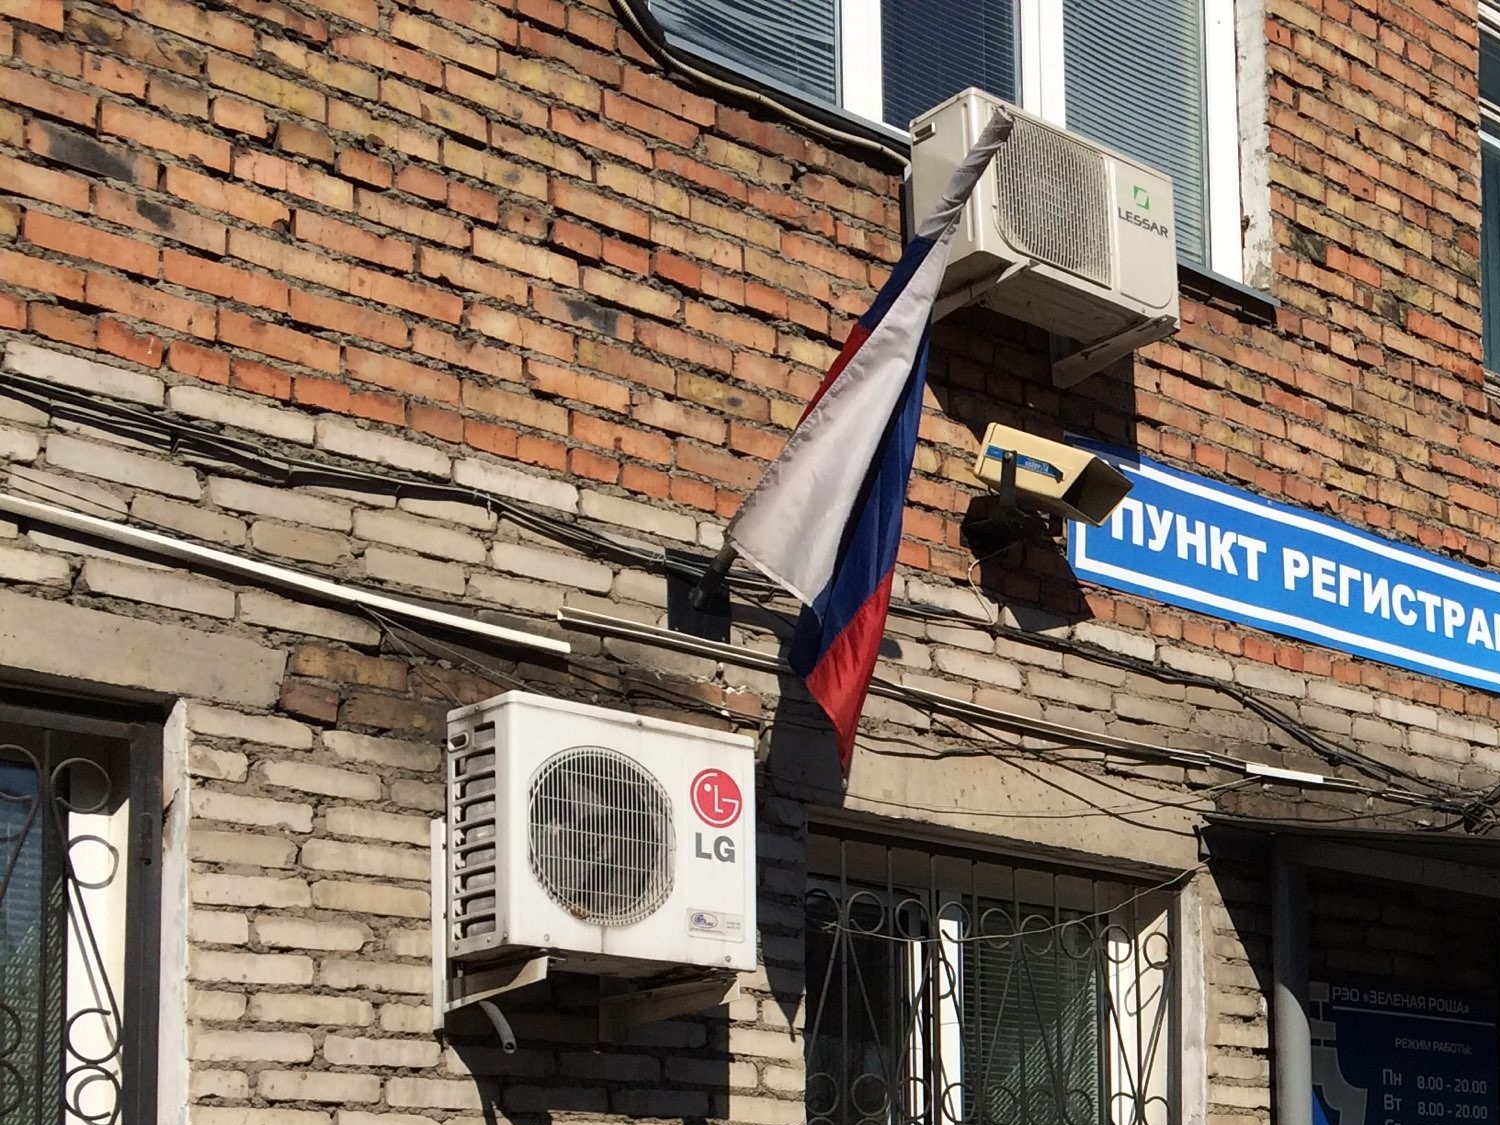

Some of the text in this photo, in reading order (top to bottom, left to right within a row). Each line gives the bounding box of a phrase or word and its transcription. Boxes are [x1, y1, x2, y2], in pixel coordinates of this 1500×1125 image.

[1118, 207, 1169, 239] LESSAR
[1111, 496, 1267, 582] ПУНКТ
[695, 832, 736, 863] LG
[1332, 986, 1360, 1003] РЭО
[1394, 1037, 1432, 1052] РЕЖИМ
[1382, 1069, 1403, 1086] Пн
[1416, 1076, 1443, 1091] 8.00
[1454, 1078, 1488, 1094] 20.00
[1383, 1094, 1403, 1111] Вт
[1417, 1101, 1444, 1117] 8.00
[1455, 1104, 1488, 1119] 20.00
